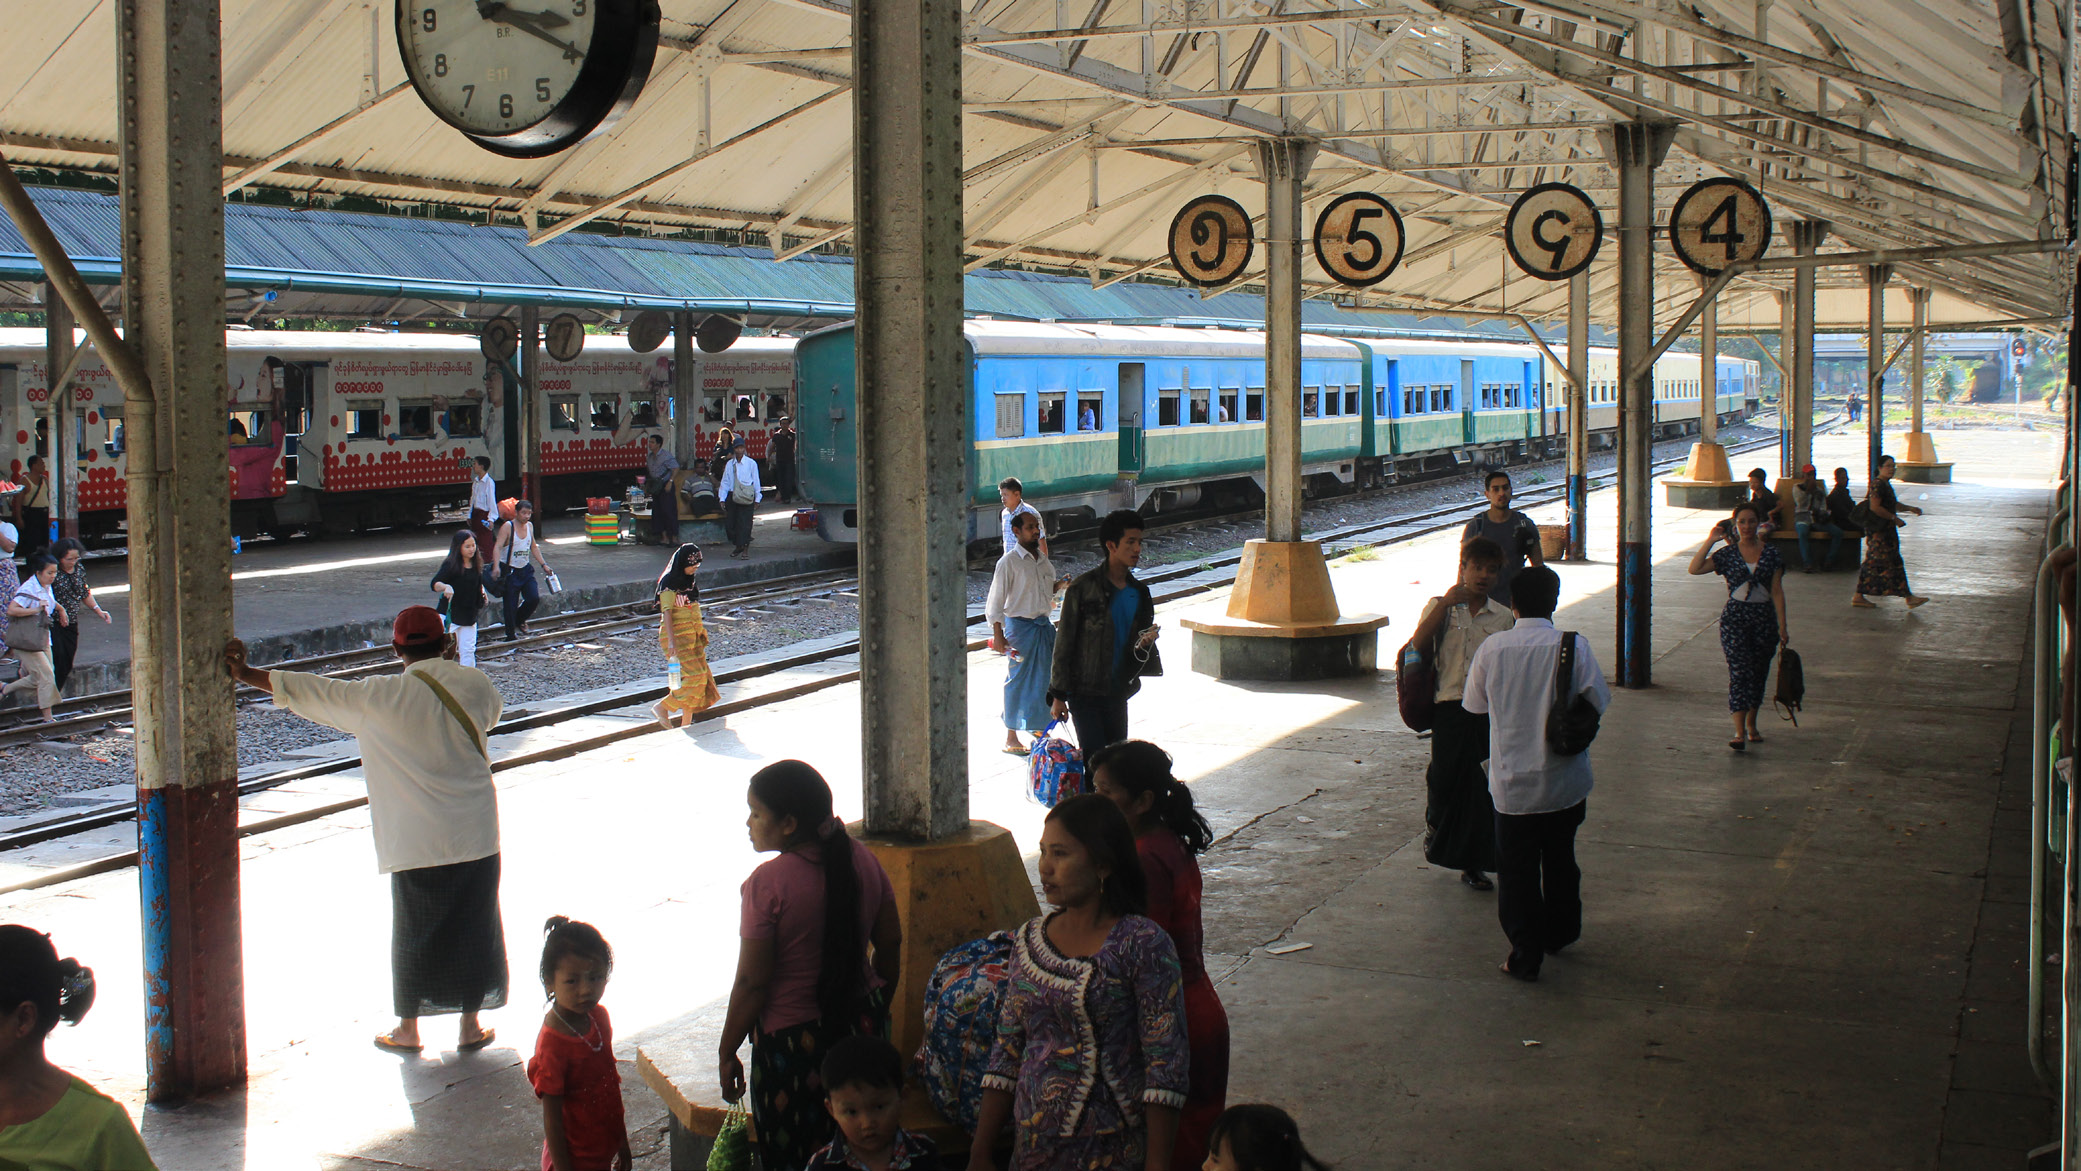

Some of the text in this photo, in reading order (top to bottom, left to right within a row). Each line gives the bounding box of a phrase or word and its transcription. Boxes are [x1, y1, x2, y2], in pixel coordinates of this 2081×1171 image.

[423, 8, 437, 32] 9
[572, 0, 587, 17] 3
[434, 53, 449, 78] 8
[562, 41, 579, 65] 4
[462, 84, 475, 109] 7
[535, 77, 551, 103] 5
[499, 93, 514, 118] 6
[1343, 208, 1384, 271] 5
[1701, 195, 1745, 261] 4
[556, 321, 575, 356] 7
[335, 381, 384, 393] ooredoo
[538, 379, 572, 391] oredoo
